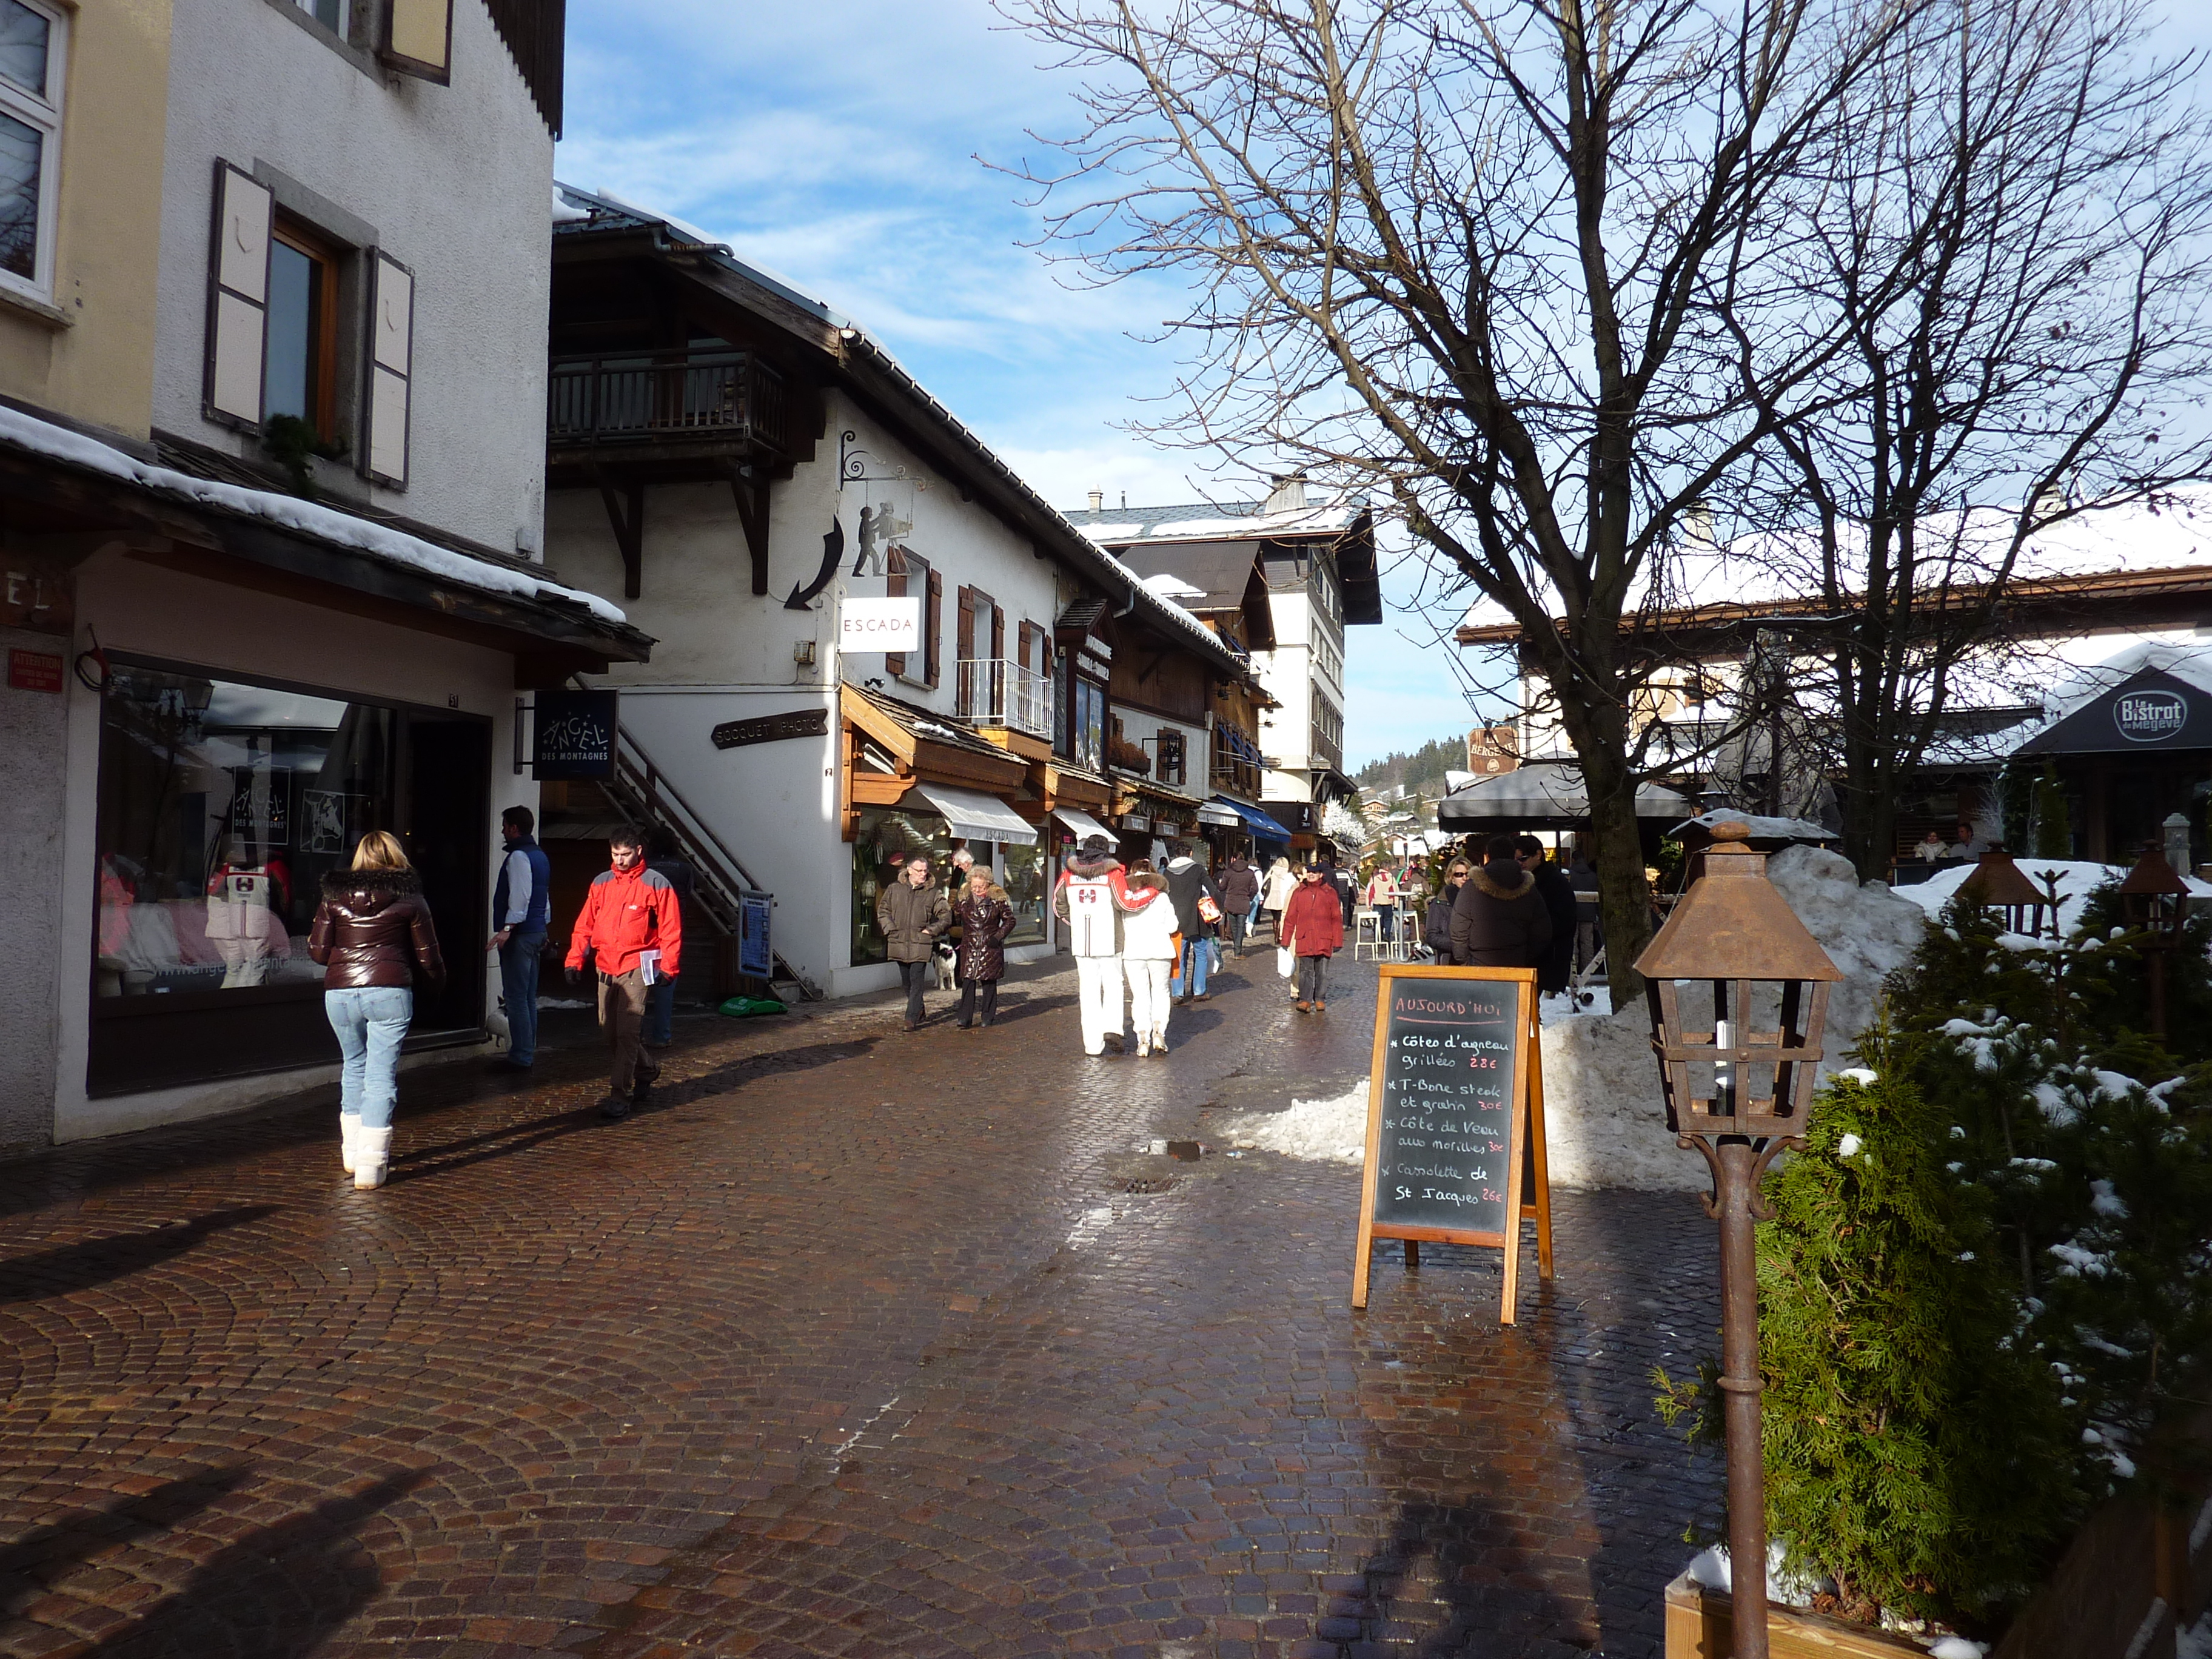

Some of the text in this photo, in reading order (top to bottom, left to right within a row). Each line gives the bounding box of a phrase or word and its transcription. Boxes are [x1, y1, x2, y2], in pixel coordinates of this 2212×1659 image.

[844, 619, 913, 631] ESCADA
[14, 652, 61, 669] ATTENTION
[449, 694, 458, 707] 51
[2136, 699, 2146, 708] Le
[2122, 700, 2181, 721] Bistrot
[543, 717, 609, 749] ANGEL
[716, 719, 819, 743] SOCQUET PHOTO
[560, 752, 608, 760] MONTAGNES
[1470, 742, 1515, 757] BERGEIE
[1403, 1034, 1509, 1057] Côtes d'agneau
[1402, 1052, 1497, 1070] grillées 28€
[1399, 1079, 1501, 1098] T-Bone steak
[1401, 1096, 1503, 1114] et gratin 30€
[1400, 1116, 1498, 1136] Côte de Veau
[1398, 1137, 1504, 1155] aux morilles 30€
[1397, 1163, 1488, 1180] Cassolette de
[1395, 1186, 1503, 1207] St Jacques 26€
